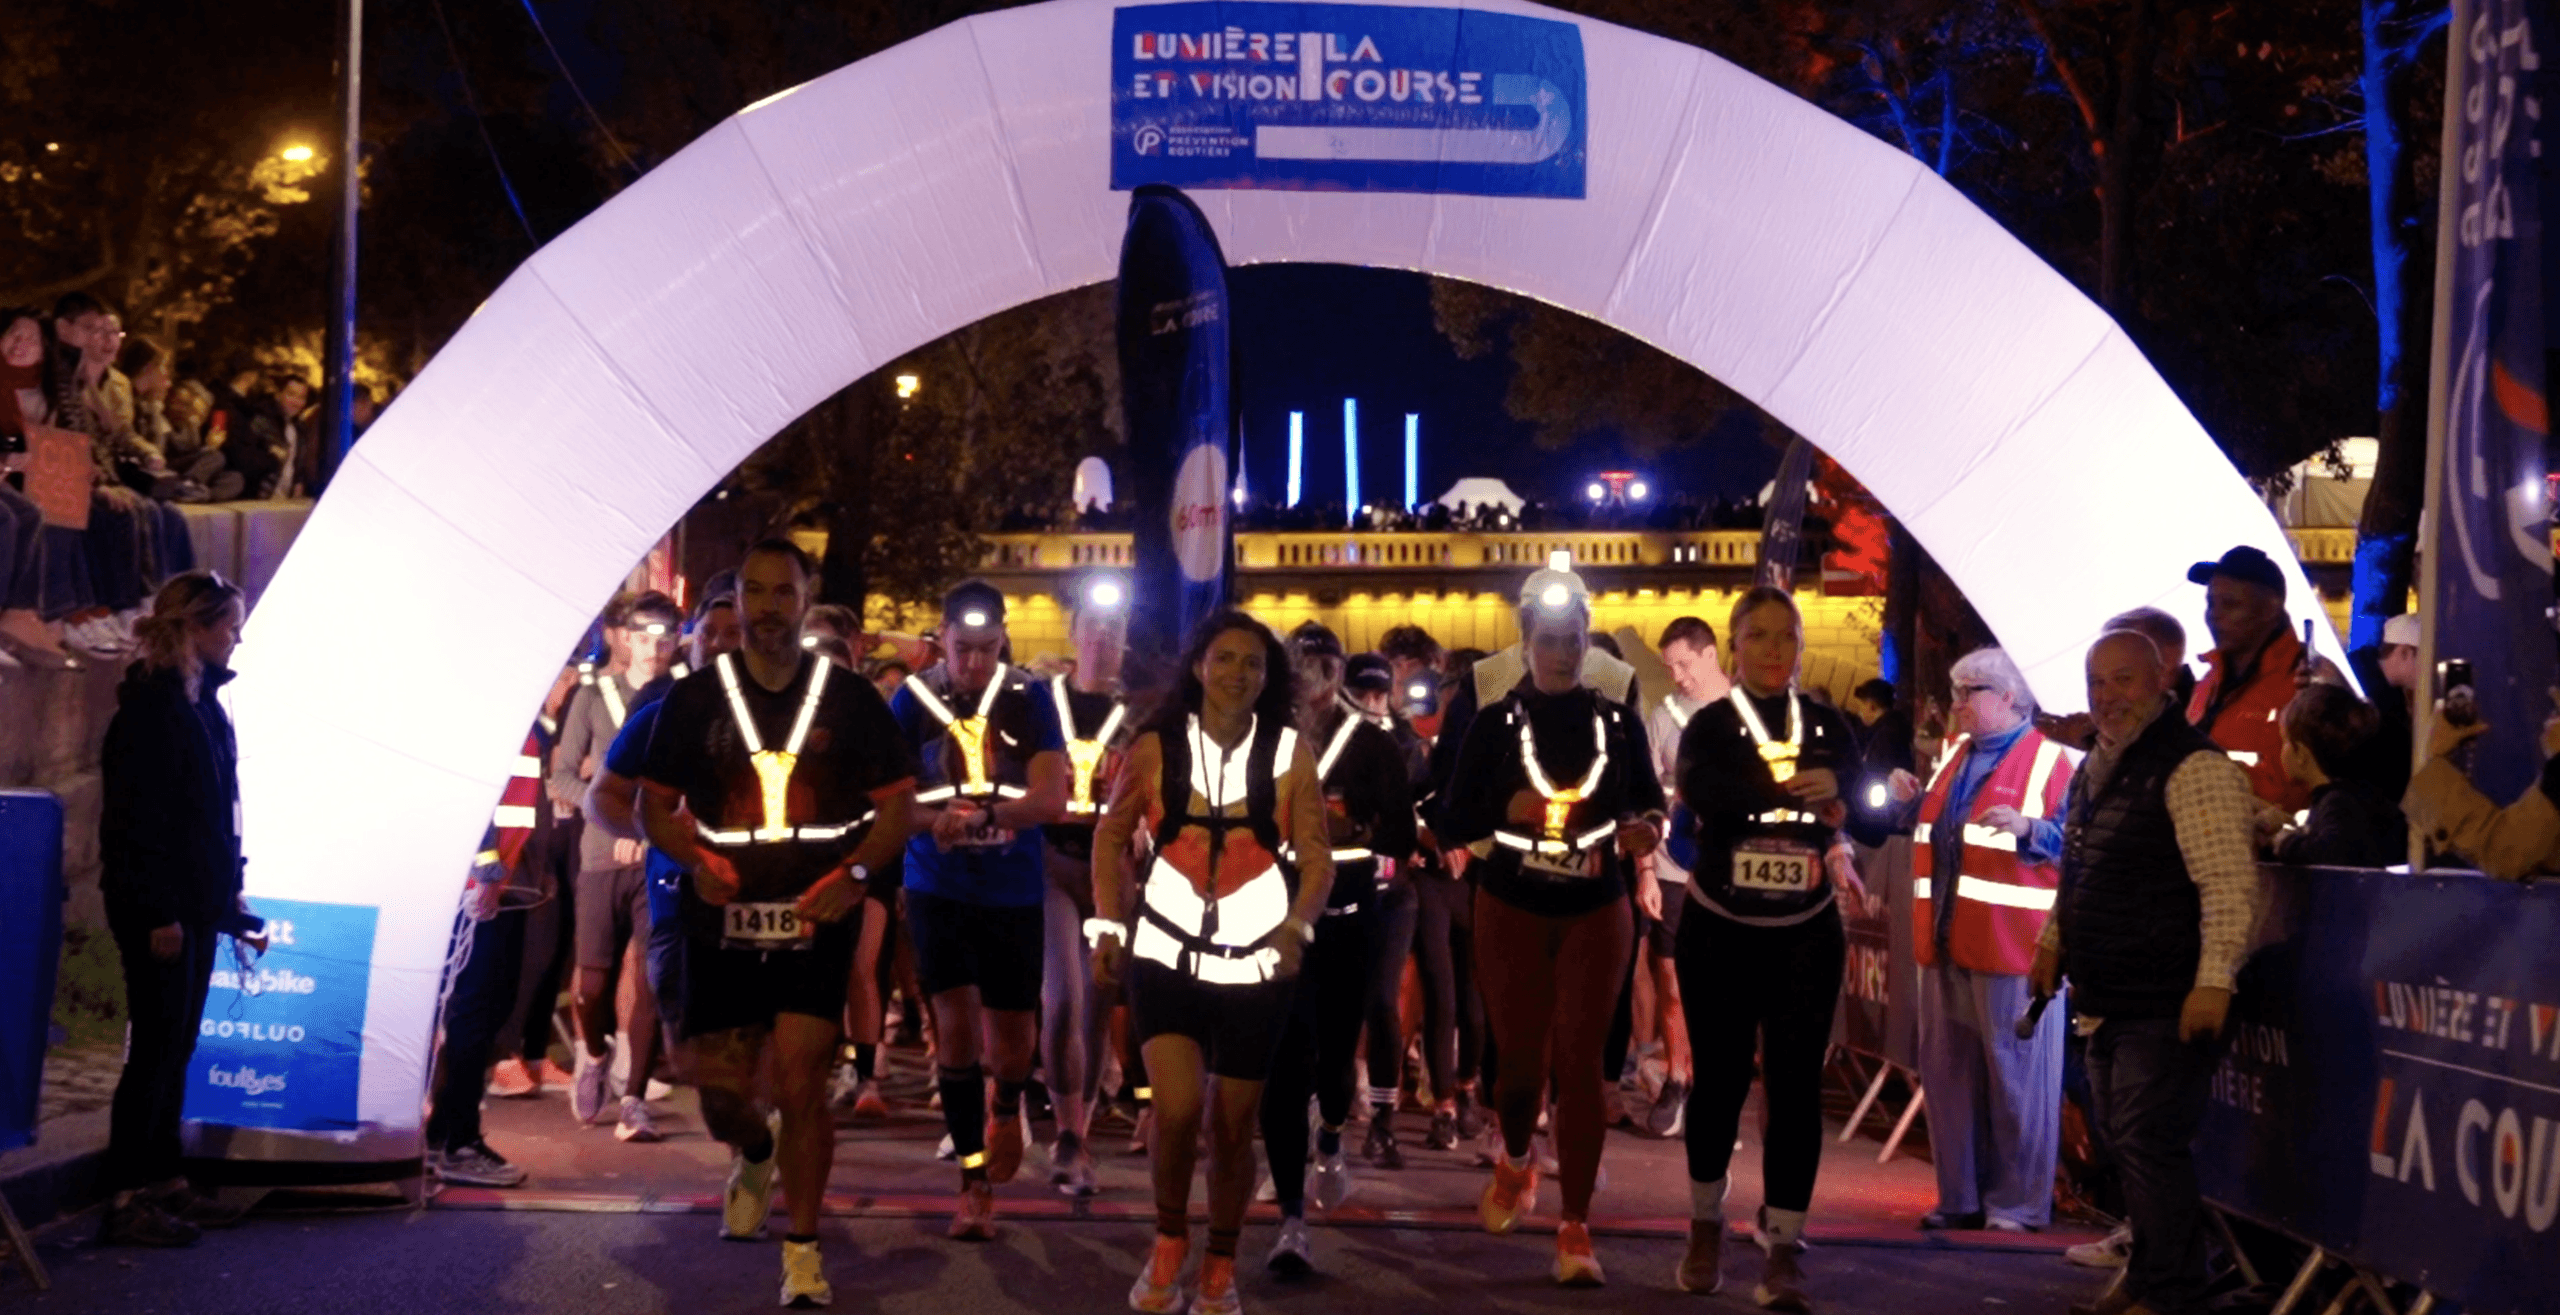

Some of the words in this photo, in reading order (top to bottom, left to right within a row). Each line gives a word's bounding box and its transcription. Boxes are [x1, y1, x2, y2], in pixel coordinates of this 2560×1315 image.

[1133, 26, 1296, 61] LUMIÈRE
[1326, 33, 1382, 62] LA
[1134, 72, 1176, 98] ET
[1188, 72, 1296, 99] VISION
[1325, 69, 1482, 103] COURSE
[1742, 860, 1803, 884] 1433
[732, 909, 796, 932] 1418
[208, 968, 316, 997] asybike
[2373, 974, 2479, 1043] LUMIÈRE
[2481, 995, 2519, 1050] ET
[2369, 1077, 2436, 1193] LA
